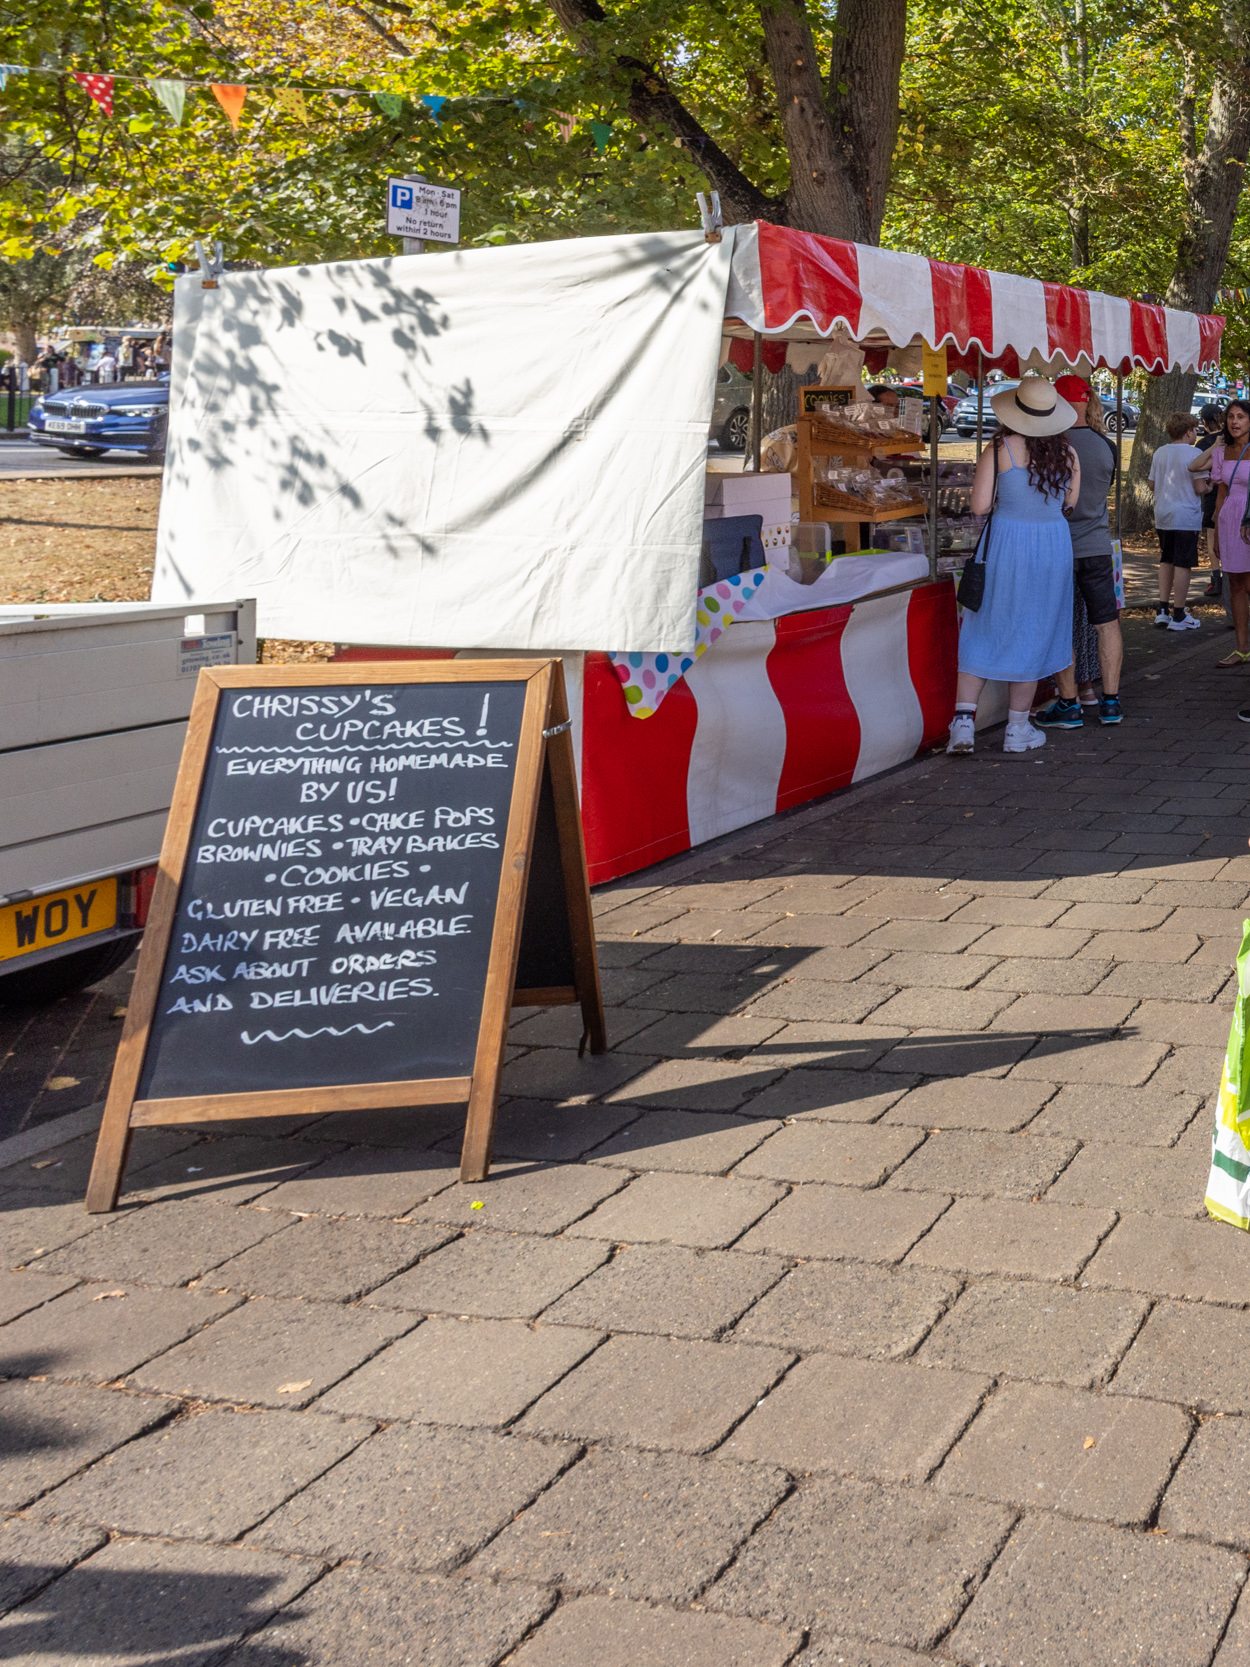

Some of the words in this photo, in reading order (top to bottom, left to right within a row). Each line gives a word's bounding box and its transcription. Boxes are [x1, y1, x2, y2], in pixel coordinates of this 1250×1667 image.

[419, 187, 435, 195] Mon
[441, 190, 455, 199] Sat
[406, 217, 417, 225] No
[420, 220, 443, 229] return
[430, 210, 448, 218] hour
[396, 225, 420, 233] within
[430, 230, 451, 239] hours
[232, 690, 397, 718] CHRISSY'S
[296, 717, 466, 740] CUPCAKES
[226, 755, 363, 776] EVERYTHING
[370, 753, 509, 774] HOMEMADE
[300, 781, 340, 803] BY
[347, 777, 398, 804] US!
[207, 814, 344, 838] CUPCAKES
[361, 810, 425, 833] CAKE
[434, 806, 496, 829] POPS
[196, 838, 323, 864] BROWNIES
[280, 860, 410, 887] COOKIES
[187, 896, 283, 921] GLUTEN
[287, 892, 345, 915] FREE
[370, 882, 470, 910] VEGAN
[181, 929, 260, 954] DAIRY
[262, 925, 321, 951] FREE
[169, 964, 227, 984] ASK
[232, 957, 319, 980] ABOUT
[329, 949, 438, 976] ORDERS
[166, 993, 234, 1014] AND
[249, 977, 440, 1010] DELIVERIES.
